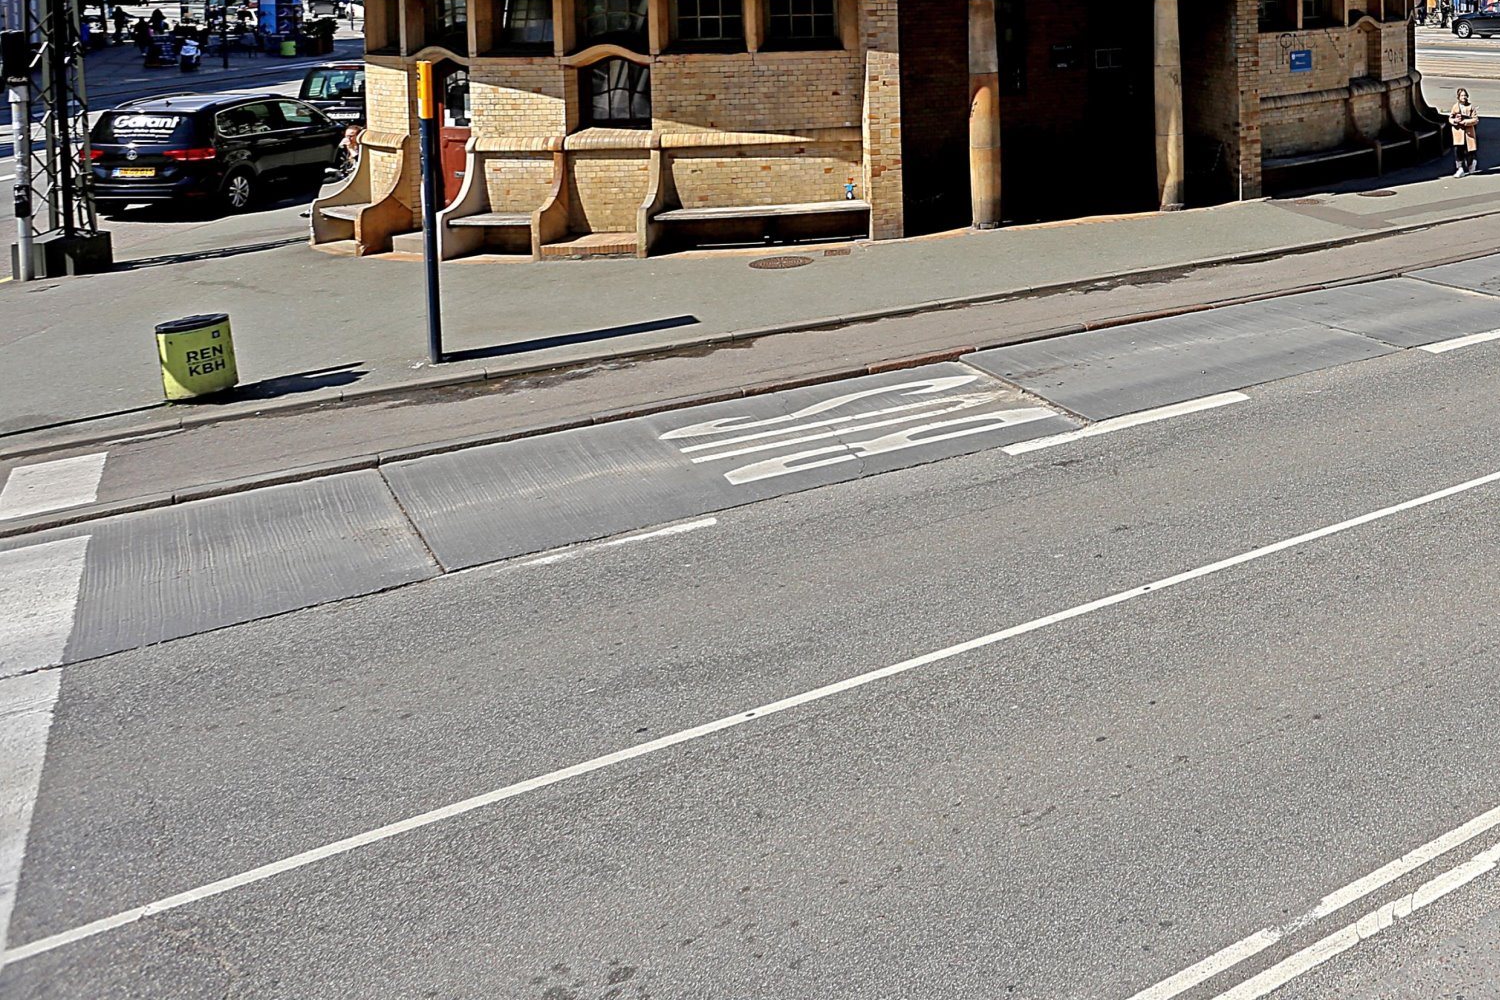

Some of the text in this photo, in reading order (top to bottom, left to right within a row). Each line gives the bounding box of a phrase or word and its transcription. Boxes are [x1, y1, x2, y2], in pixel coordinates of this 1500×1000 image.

[113, 115, 180, 128] Garant
[186, 344, 224, 363] REN
[188, 358, 226, 377] KBH
[658, 375, 1059, 486] BUS
